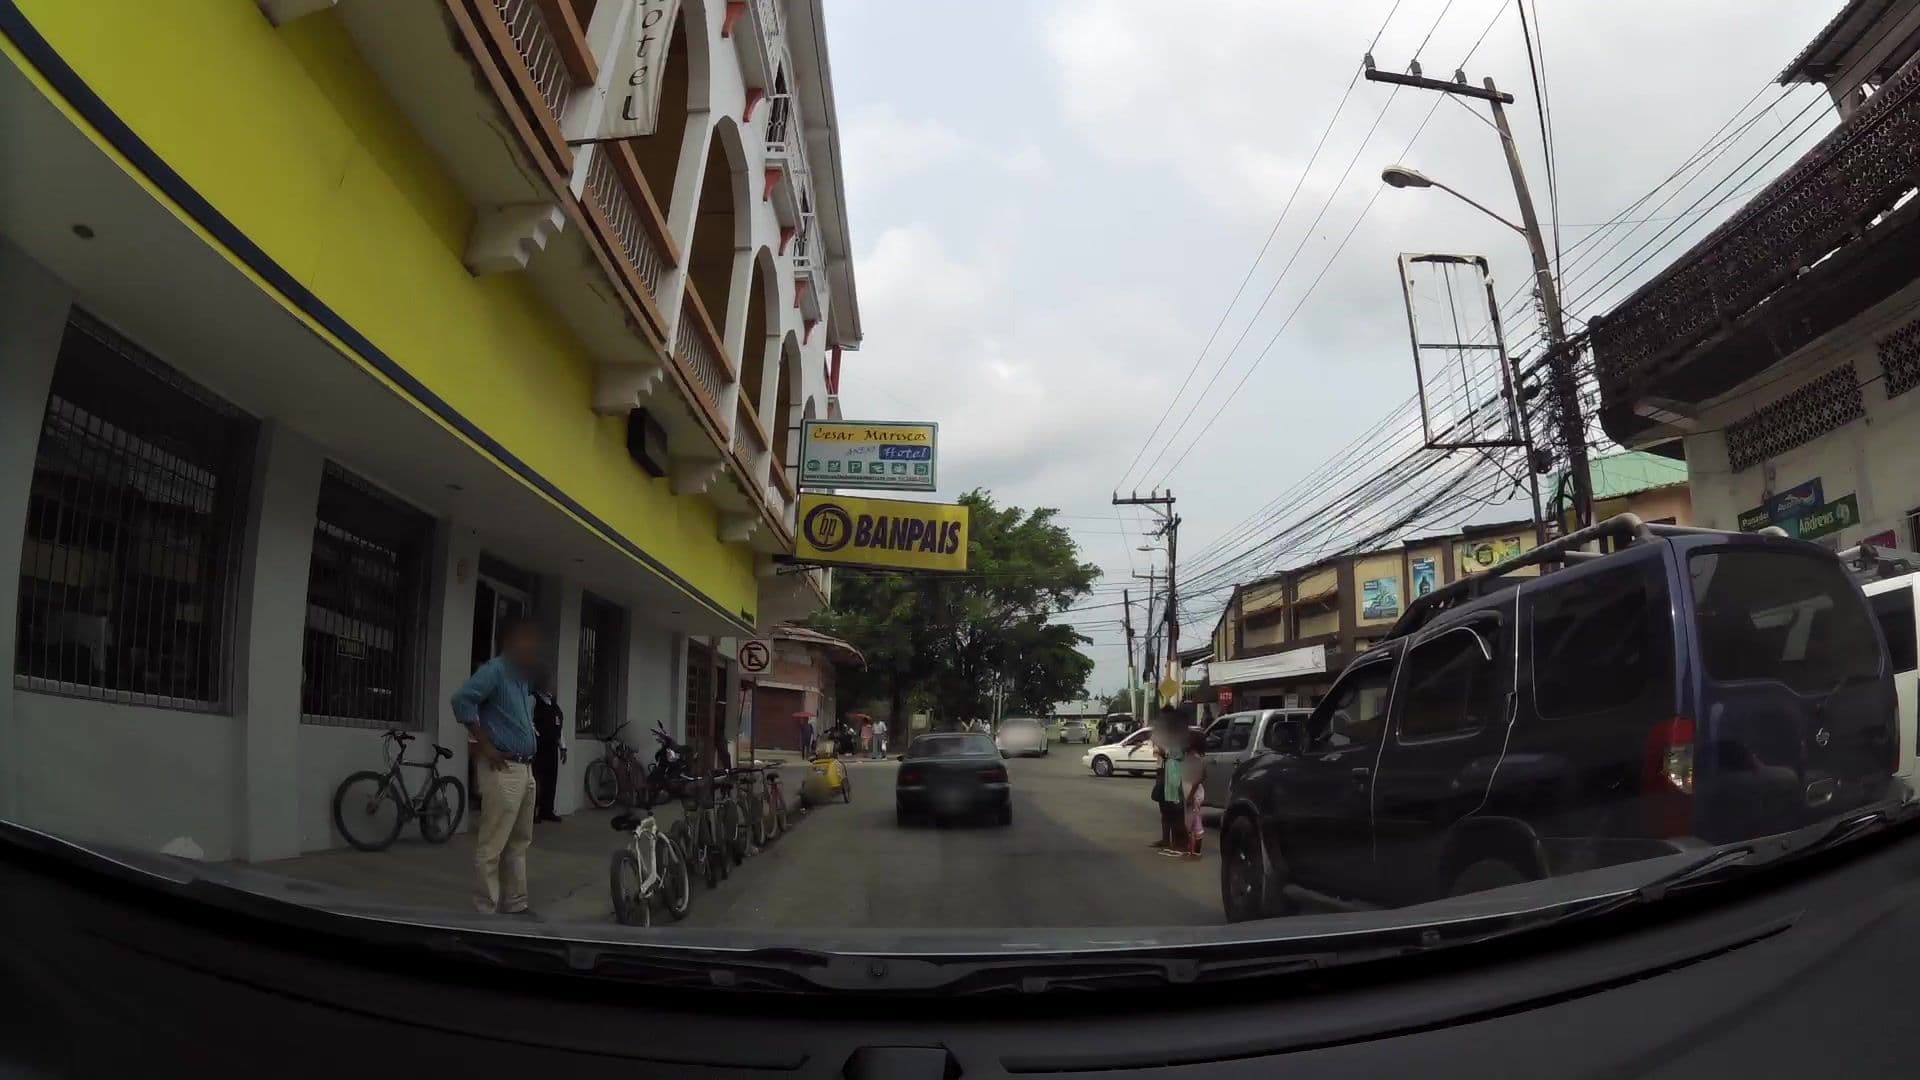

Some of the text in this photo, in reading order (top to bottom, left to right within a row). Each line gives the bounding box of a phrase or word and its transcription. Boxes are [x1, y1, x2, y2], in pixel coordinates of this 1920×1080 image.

[622, 0, 664, 121] otel
[813, 427, 928, 441] Cesar Mariscos
[884, 447, 929, 459] Hotel
[1799, 511, 1834, 534] Andrews
[854, 514, 962, 555] BANPAIS
